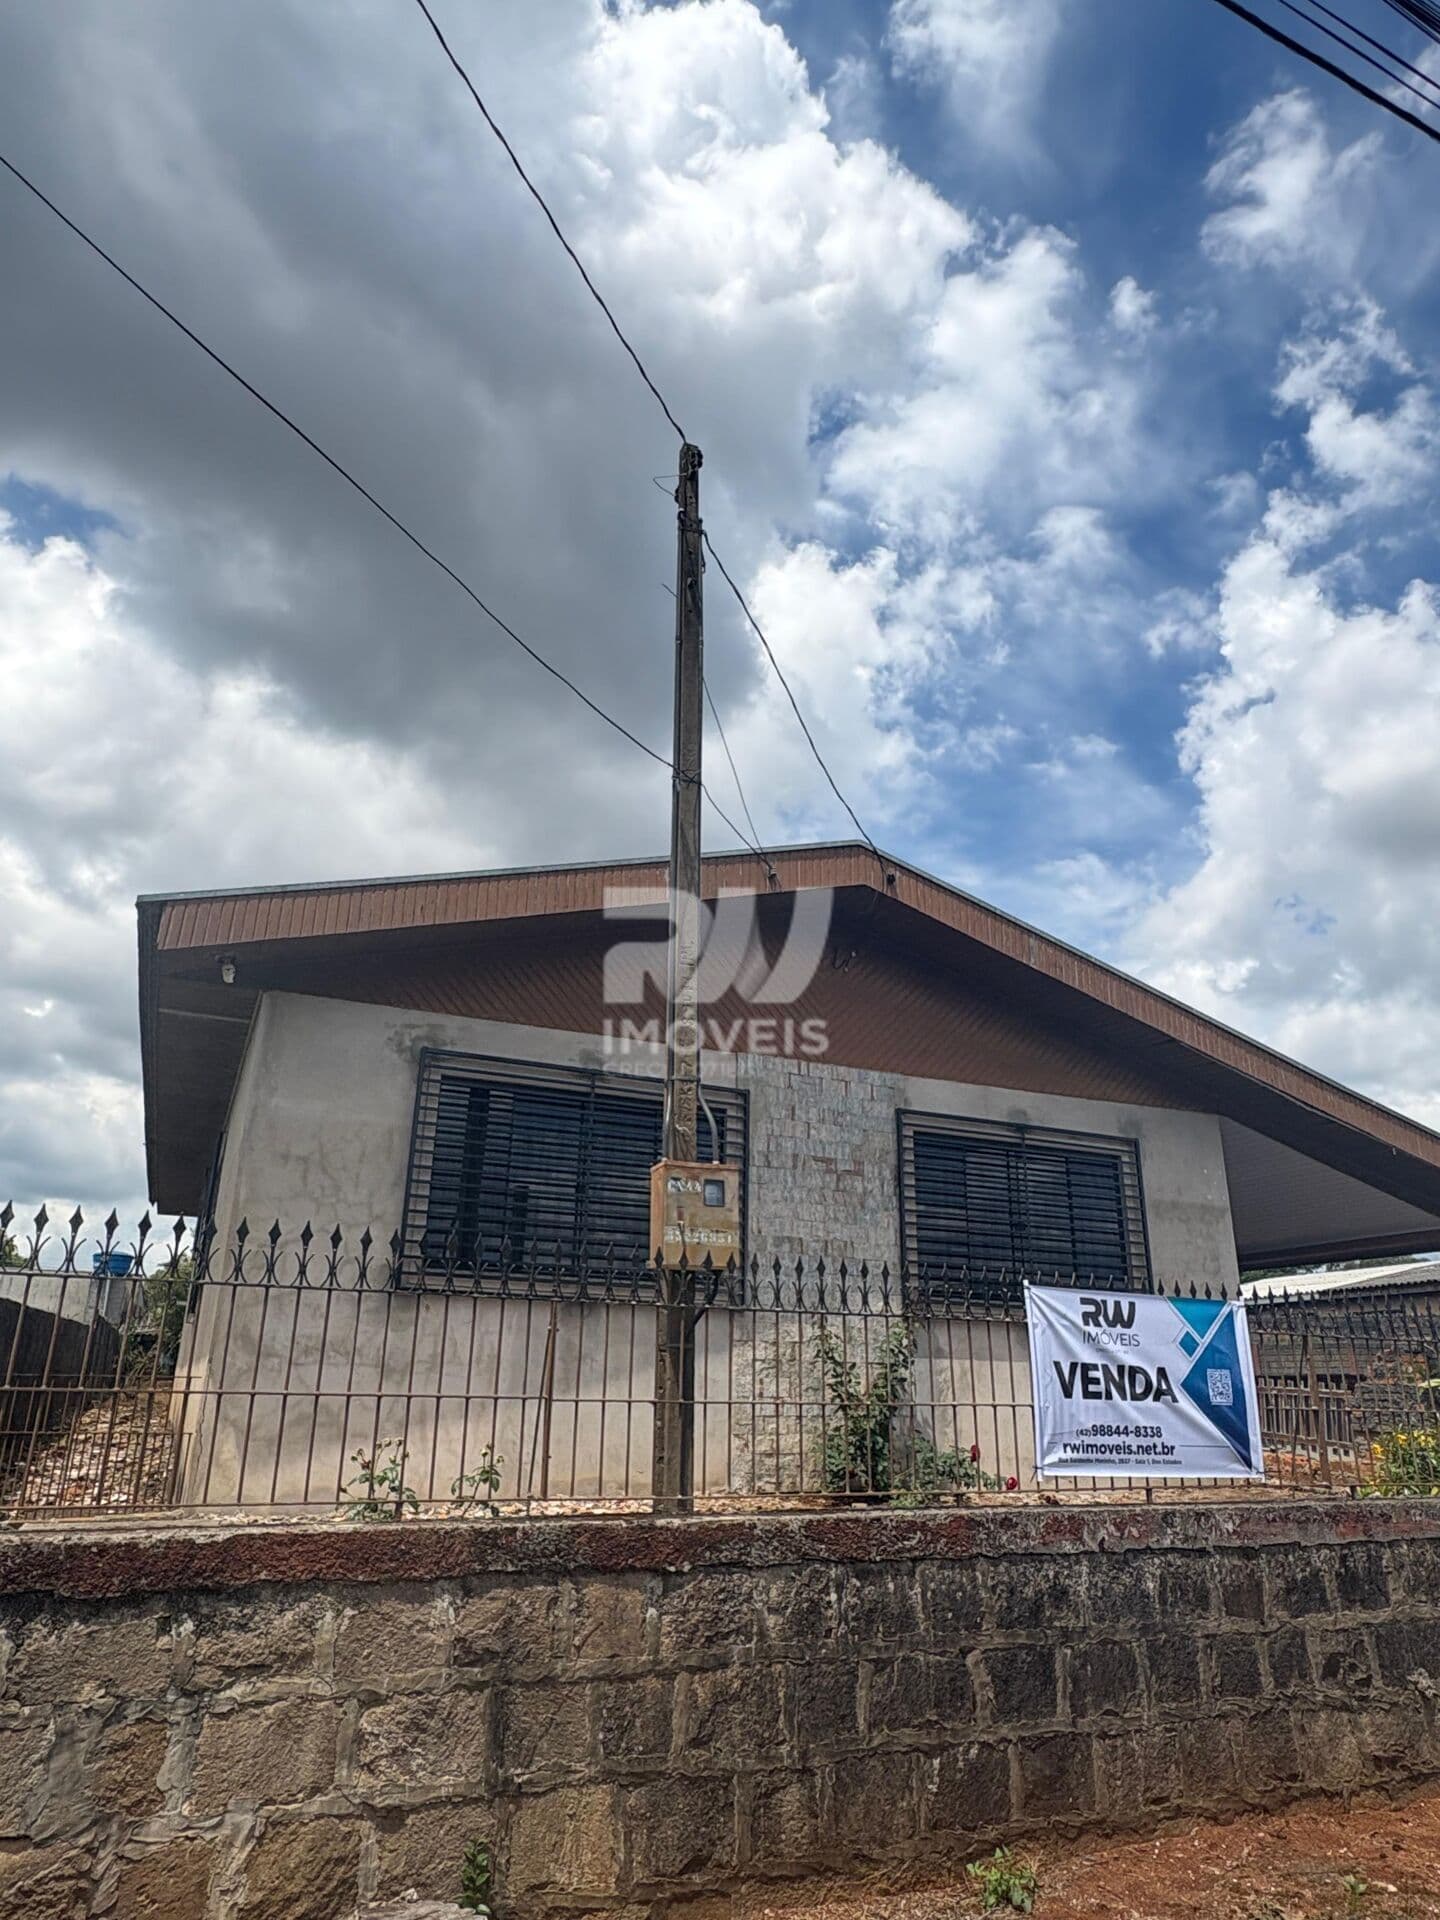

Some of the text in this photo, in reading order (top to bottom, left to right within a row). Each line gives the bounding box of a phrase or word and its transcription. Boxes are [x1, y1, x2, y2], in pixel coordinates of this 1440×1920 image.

[1079, 1297, 1136, 1329] RW
[1082, 1329, 1141, 1347] IMÓVEIS
[1053, 1360, 1179, 1403] VENDA
[1062, 1439, 1176, 1456] rwimoveis.net.br
